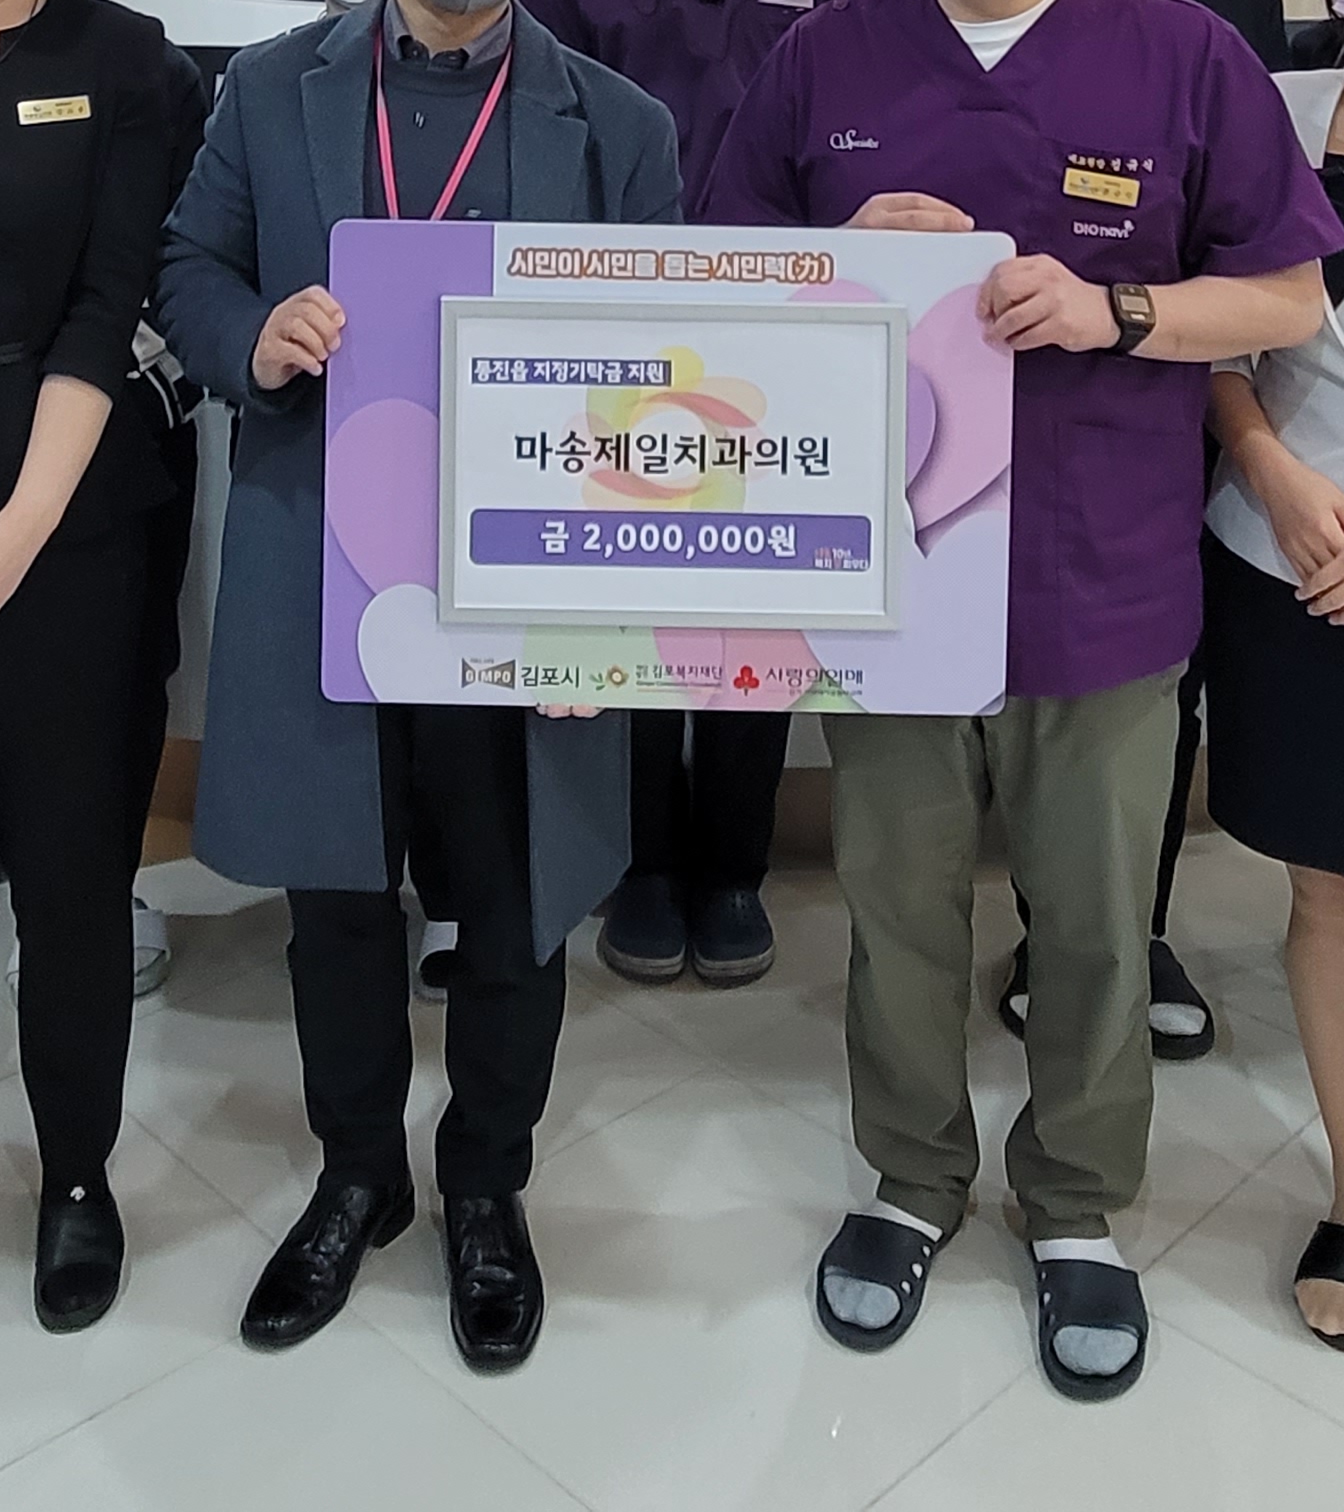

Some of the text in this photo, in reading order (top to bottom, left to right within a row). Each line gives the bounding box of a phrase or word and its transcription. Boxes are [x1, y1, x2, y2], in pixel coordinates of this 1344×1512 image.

[508, 248, 583, 279] 시민이
[584, 249, 659, 280] 시민을
[661, 251, 712, 281] 돕는
[474, 359, 665, 384] 통진읍 지정기탁금 지원
[514, 431, 831, 476] 마송제일치과의원
[540, 520, 797, 561] 금 2,000,000원
[521, 665, 580, 688] 김포시
